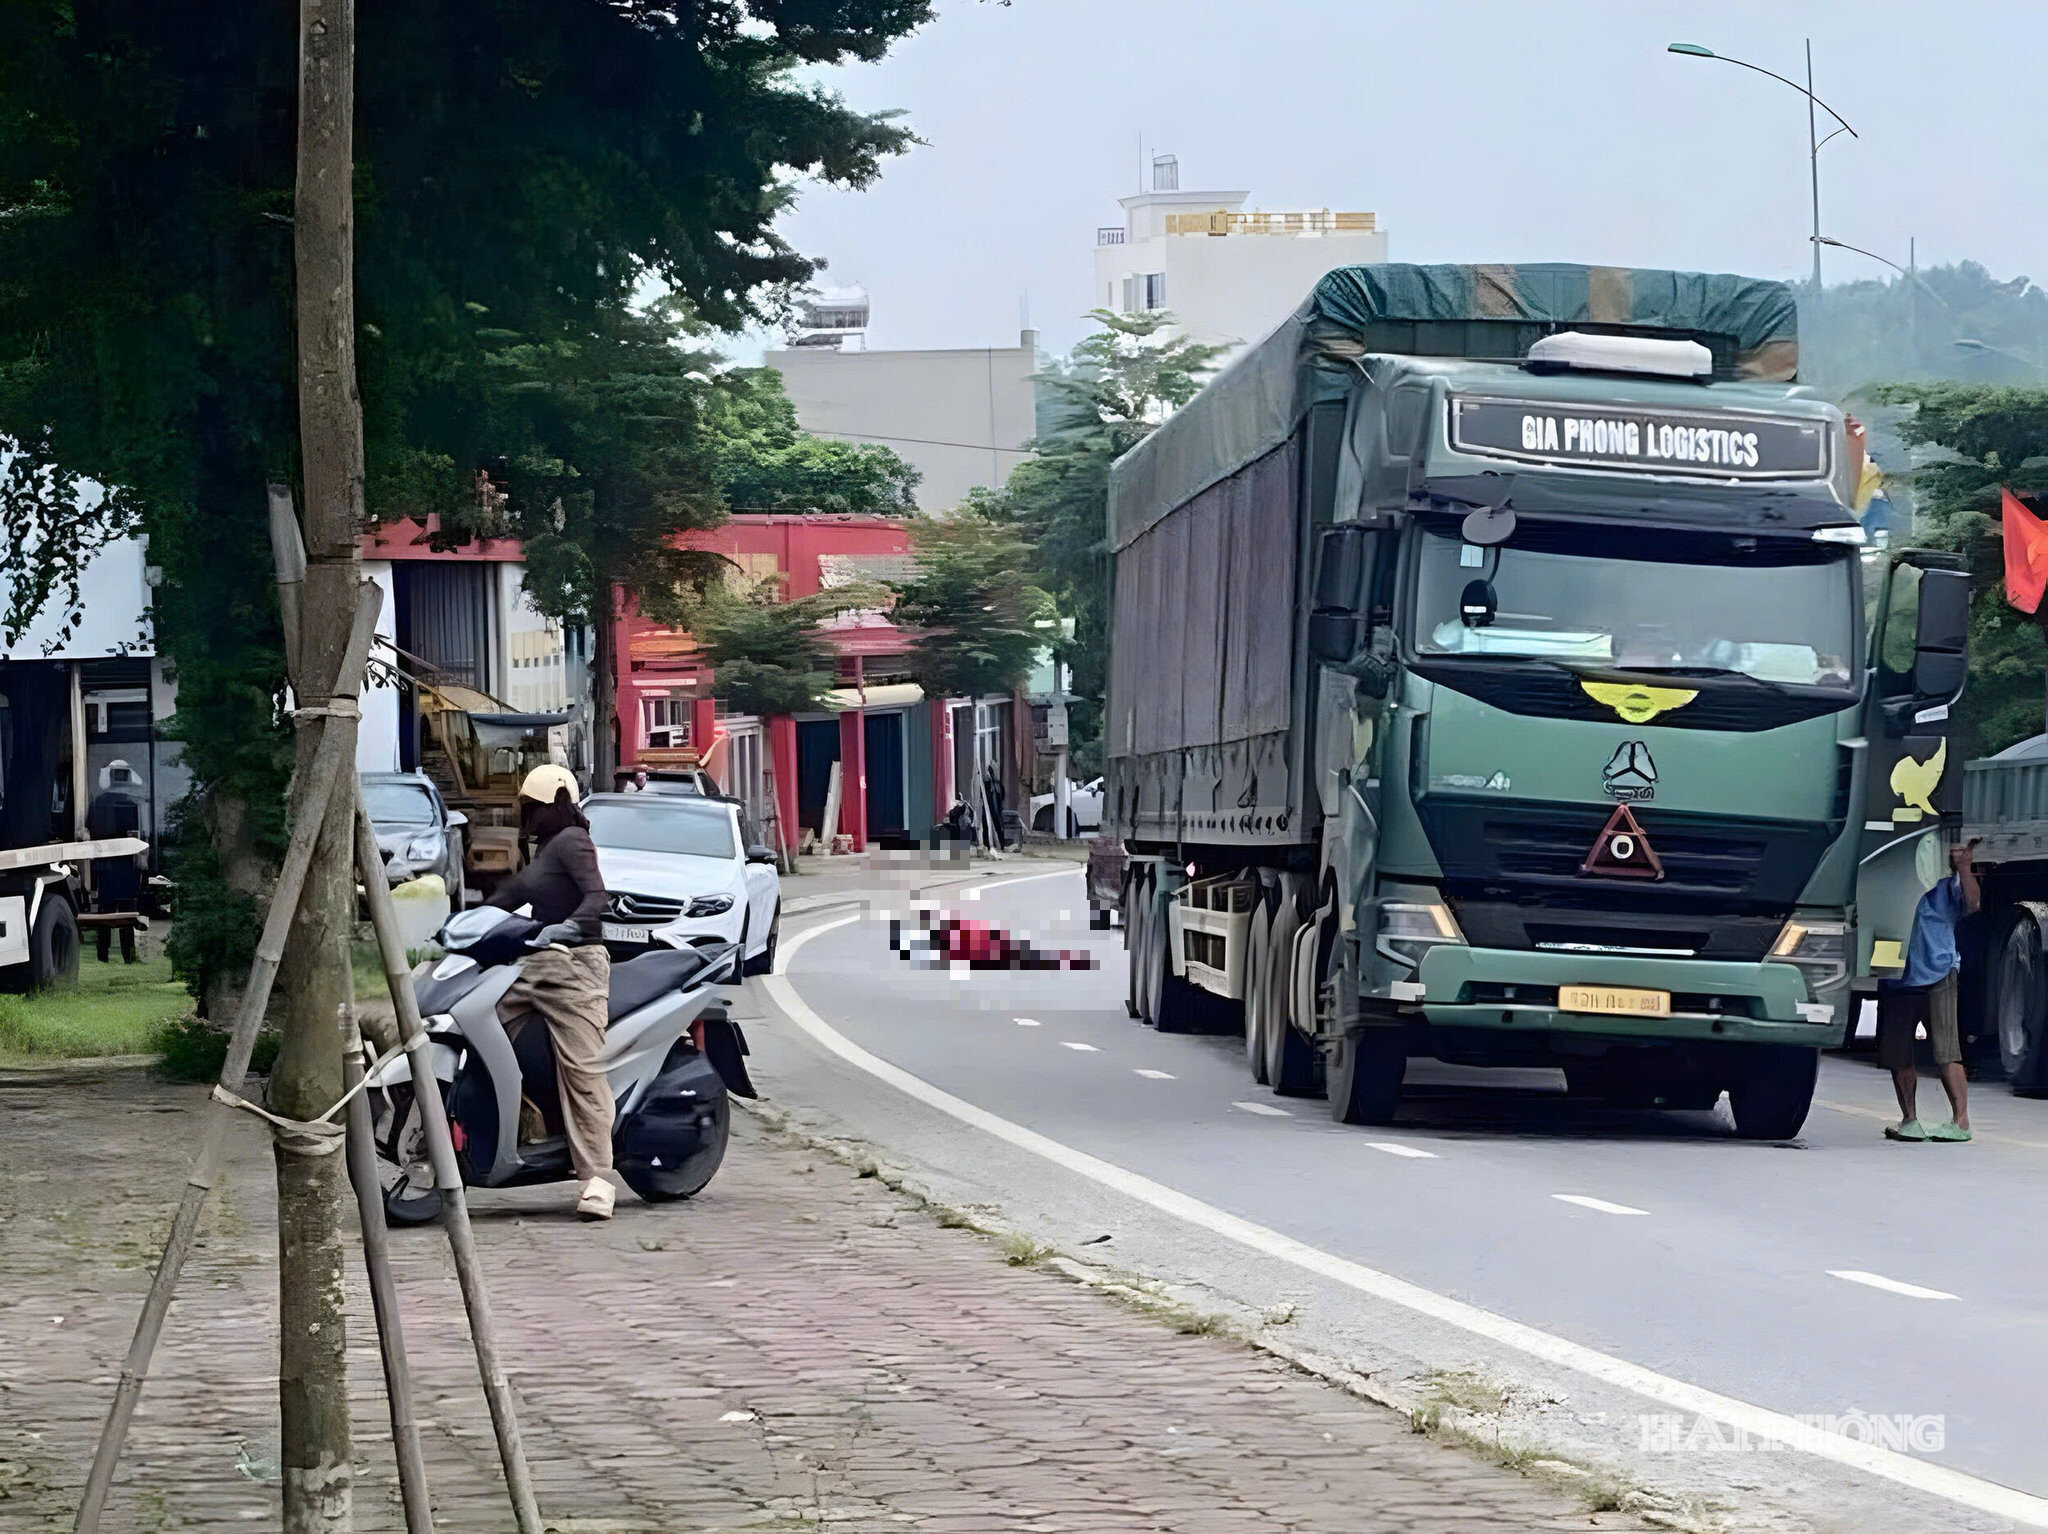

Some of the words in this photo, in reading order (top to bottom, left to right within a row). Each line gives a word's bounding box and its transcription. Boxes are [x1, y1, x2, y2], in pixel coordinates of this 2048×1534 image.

[1522, 415, 1559, 450] GIA
[1564, 418, 1639, 455] PHONG
[1647, 423, 1758, 467] LOGISTICS
